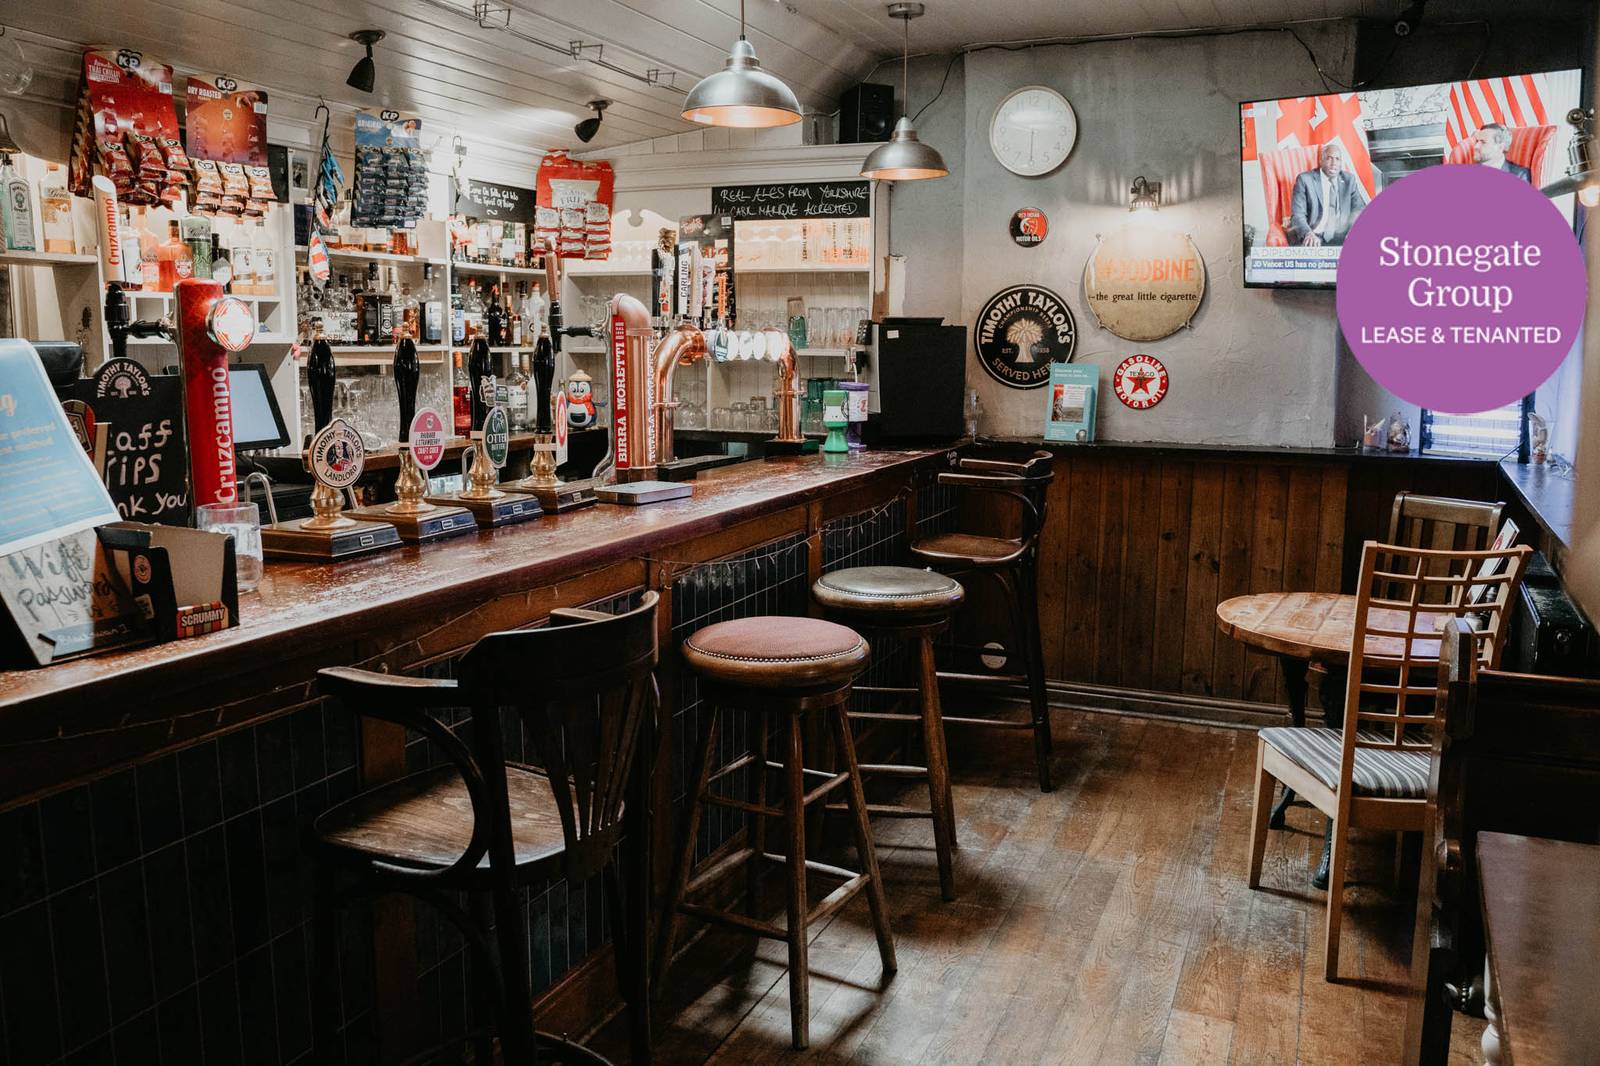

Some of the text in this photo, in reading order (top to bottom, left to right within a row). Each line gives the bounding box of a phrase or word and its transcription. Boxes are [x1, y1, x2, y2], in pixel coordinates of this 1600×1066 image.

[188, 86, 198, 95] DRY
[199, 88, 221, 99] ROASTED
[217, 79, 236, 90] KP
[382, 111, 398, 121] KP
[720, 189, 750, 202] REAL
[752, 187, 785, 201] ALES
[820, 185, 869, 204] YORKSHIRE
[730, 206, 756, 216] CASK
[759, 203, 798, 219] MARQUE
[804, 202, 857, 216] ACCREDITED
[106, 198, 120, 265] Cruzcampo
[1296, 260, 1307, 268] has
[1318, 260, 1336, 270] plans
[680, 260, 688, 298] CARLING
[1113, 294, 1134, 303] great
[1137, 292, 1156, 301] little
[1160, 292, 1197, 303] cigarette
[981, 292, 1074, 345] TIMOTHY TAYLOR'S
[616, 341, 627, 410] MORETTI
[992, 358, 1031, 380] SERVED
[1117, 356, 1167, 377] GASOLINE
[97, 363, 121, 398] TIMOTHY
[123, 362, 152, 396] TAYLOR'S
[1115, 386, 1166, 408] MOTOR OIL
[211, 367, 236, 504] Cruzcampo
[487, 433, 507, 444] OTTER
[617, 415, 627, 463] BIRRA
[316, 429, 362, 463] TIMOTHY TAYLOR'S
[492, 443, 505, 451] BITTER
[324, 464, 357, 481] LANDLORD
[181, 609, 225, 627] SCRUMMY
